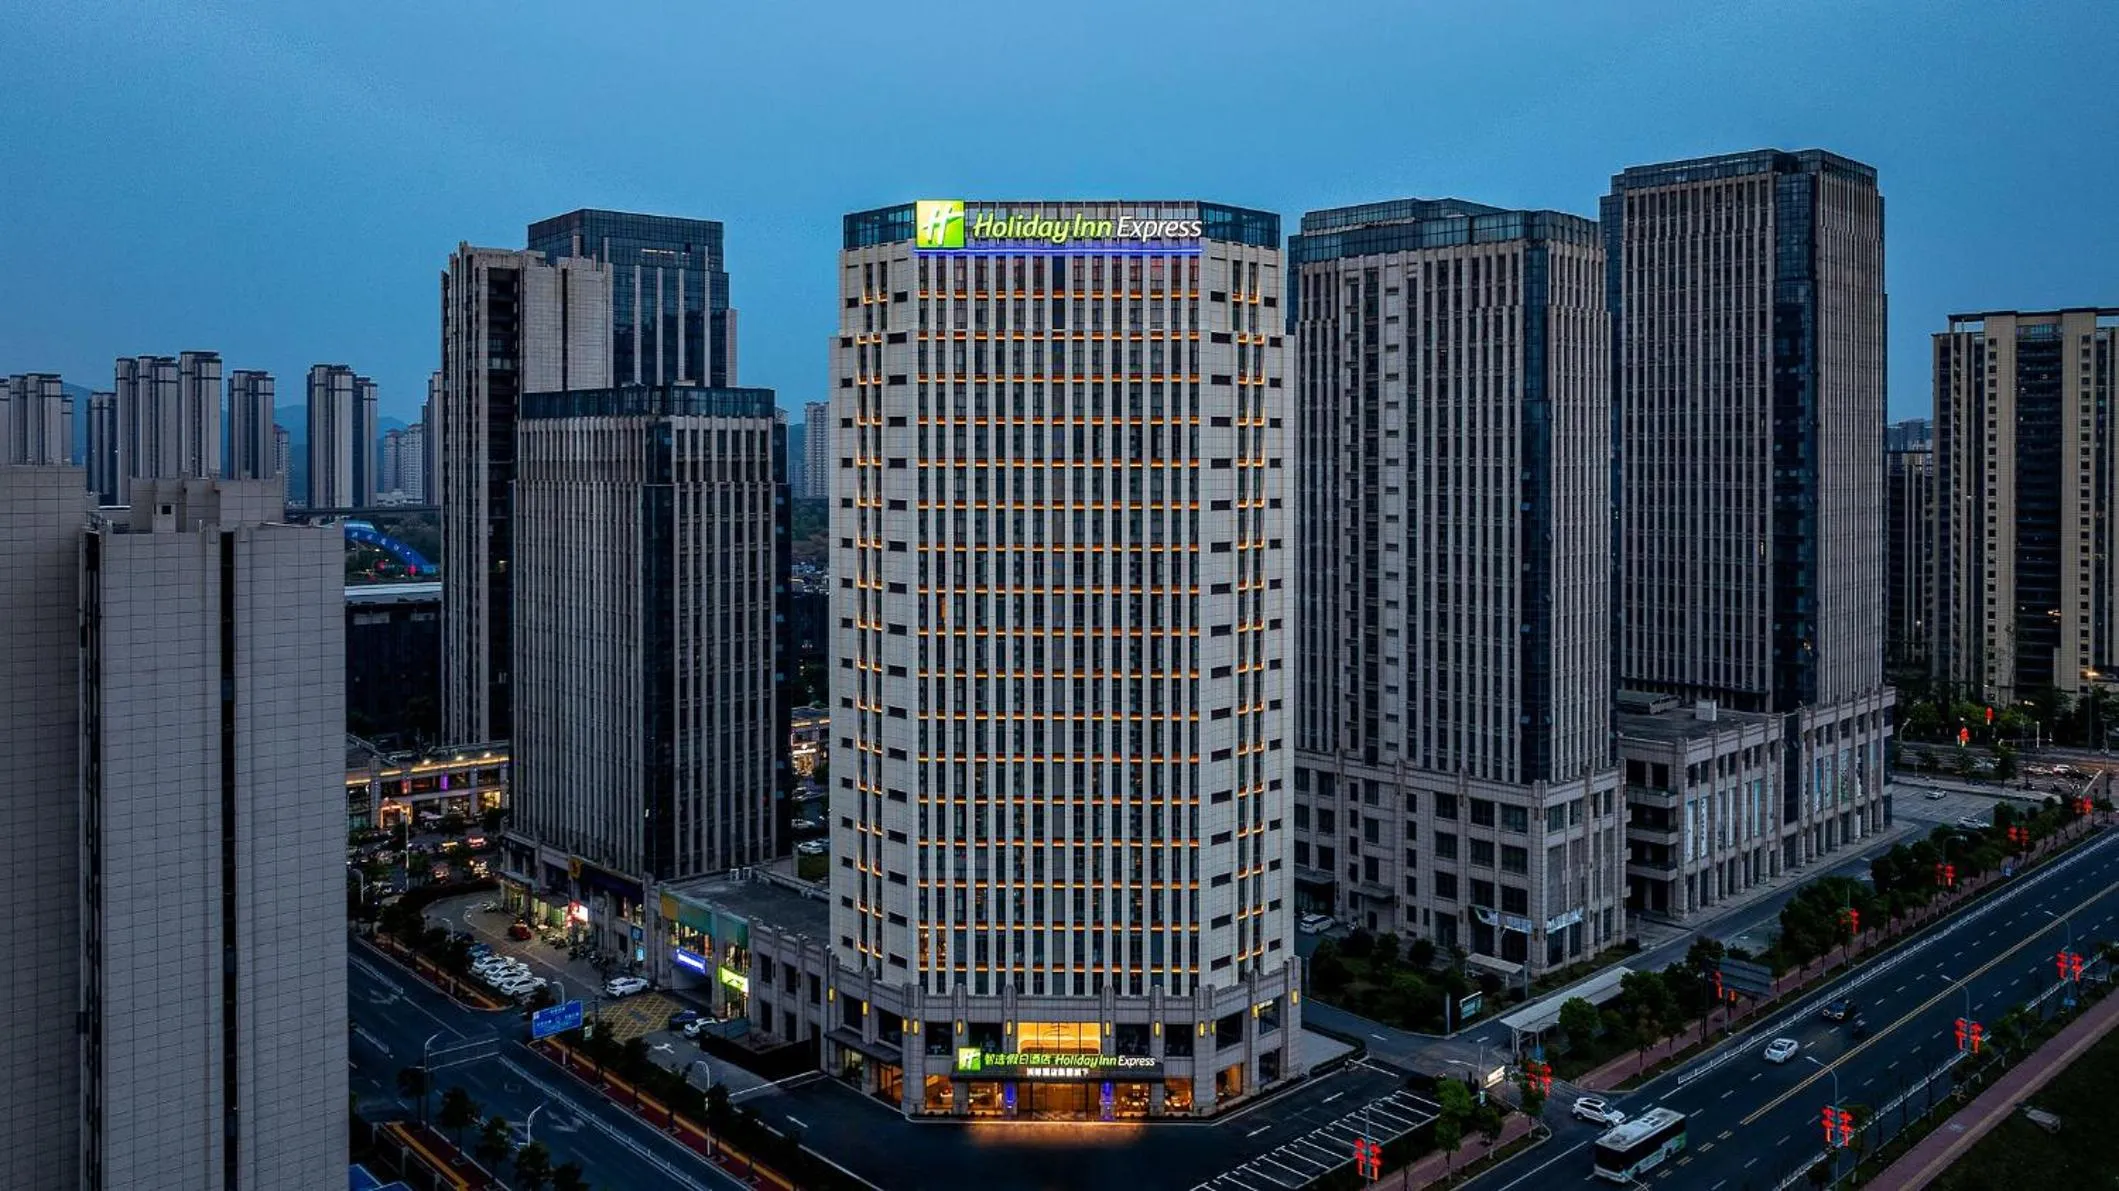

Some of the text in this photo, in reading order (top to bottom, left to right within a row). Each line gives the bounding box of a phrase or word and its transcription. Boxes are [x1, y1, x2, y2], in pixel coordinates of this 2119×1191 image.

[973, 212, 1203, 244] Holiday Inn Express
[1054, 1053, 1156, 1069] Holiday Inn Express
